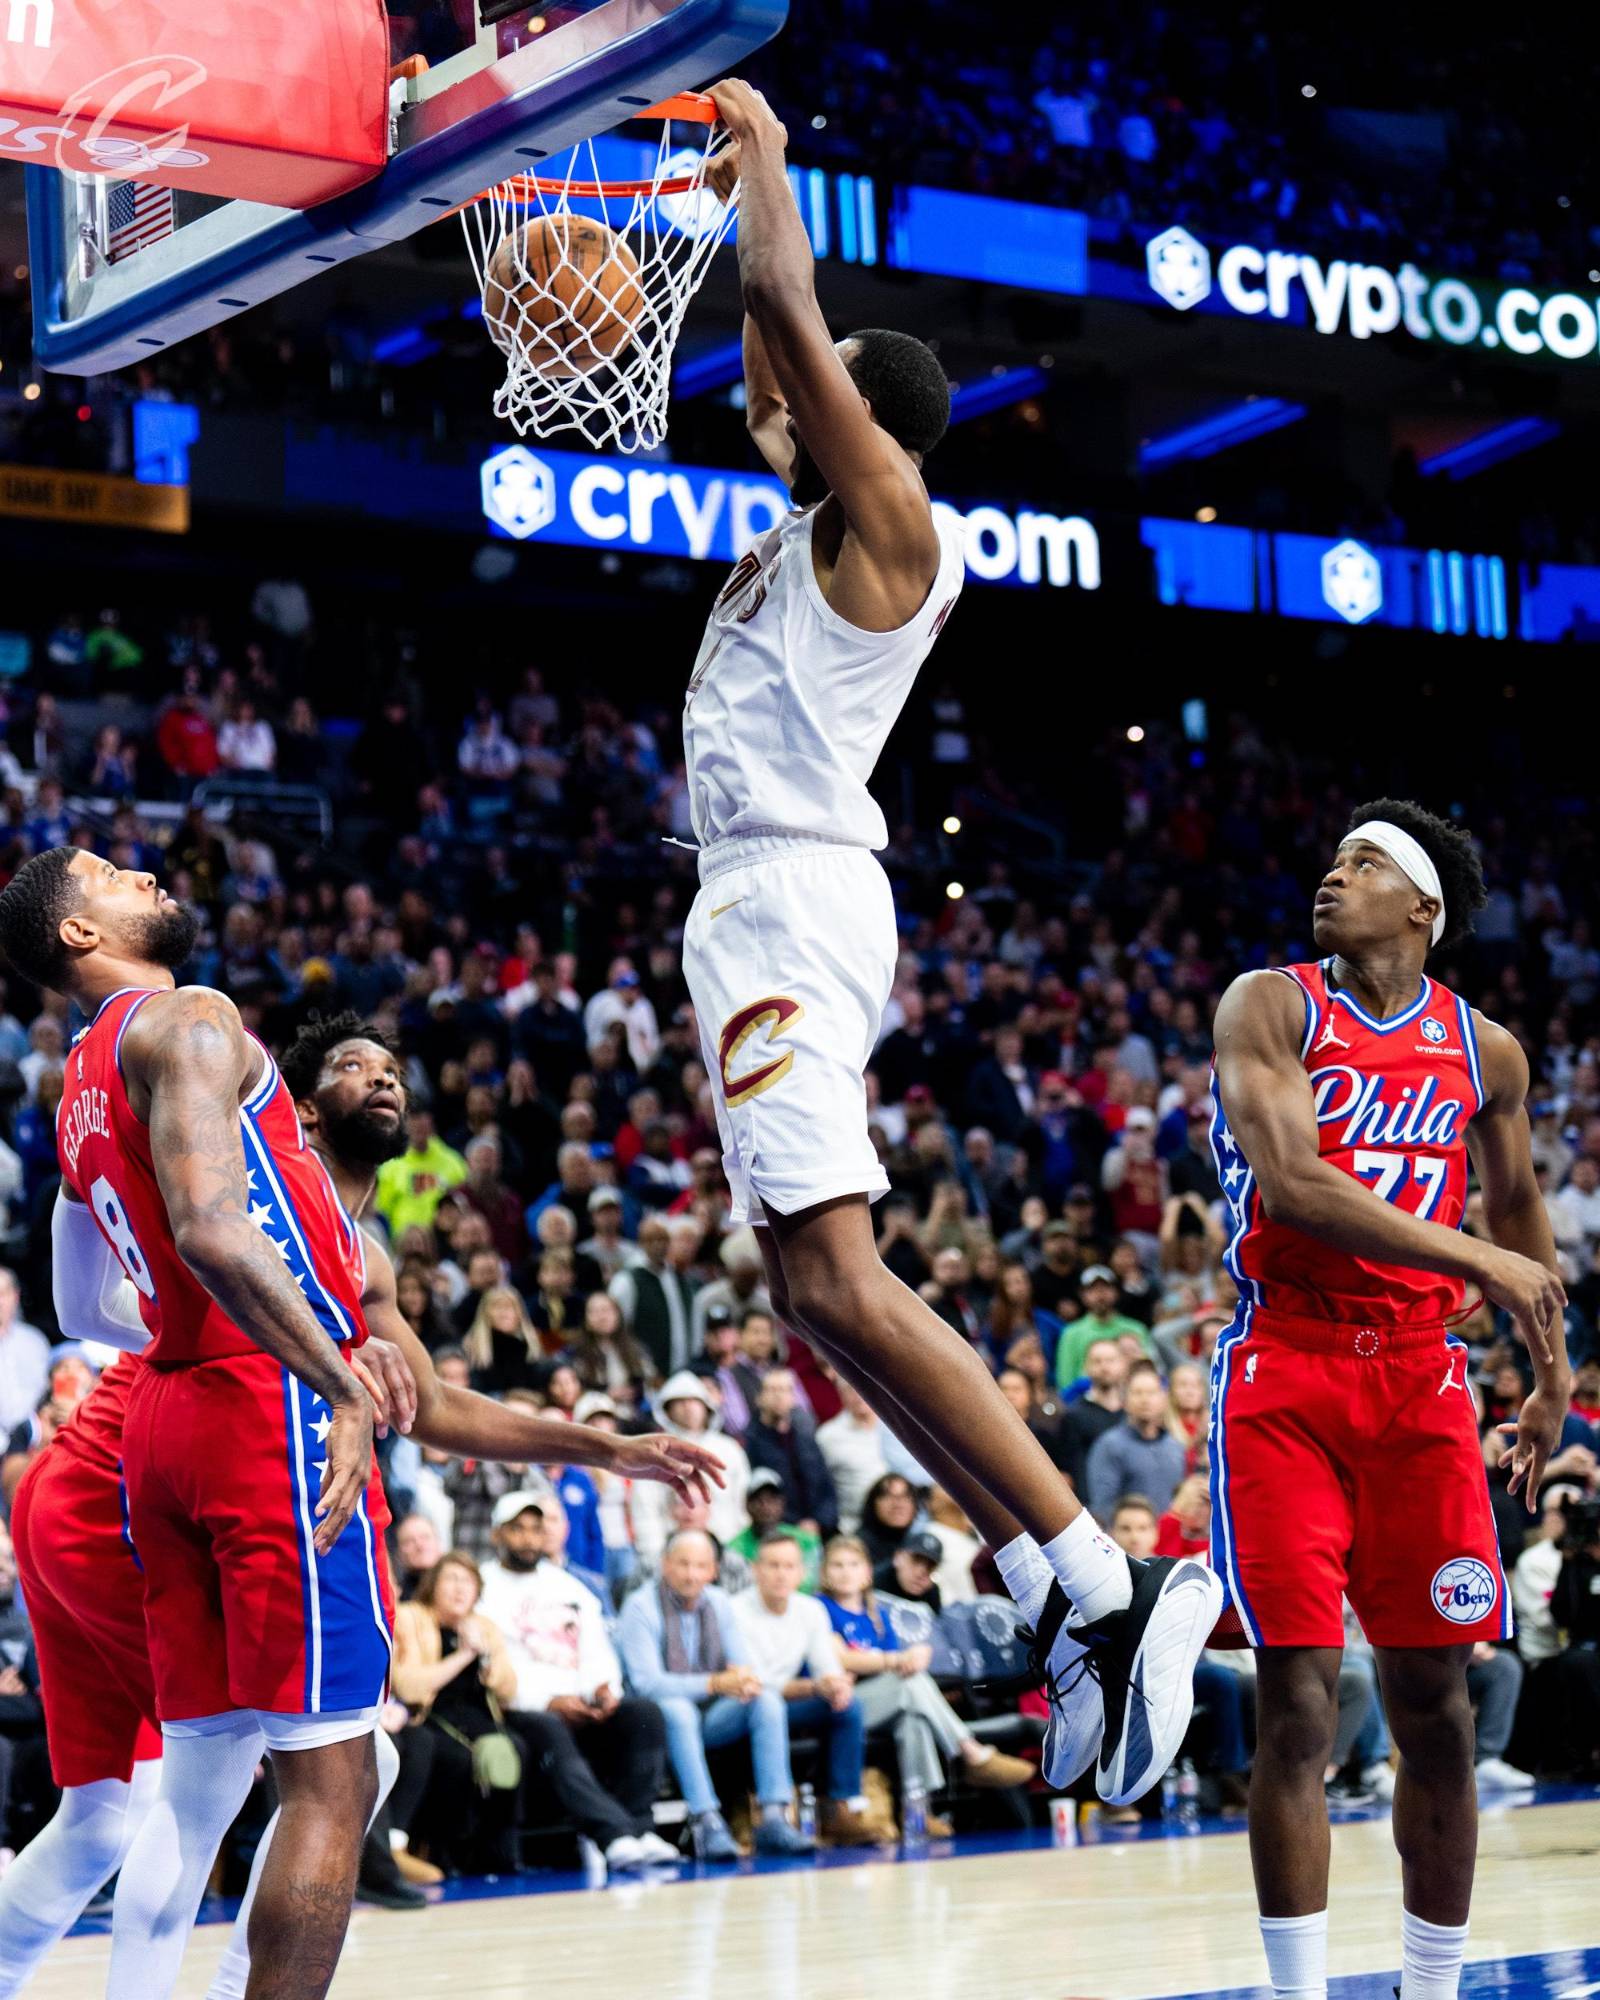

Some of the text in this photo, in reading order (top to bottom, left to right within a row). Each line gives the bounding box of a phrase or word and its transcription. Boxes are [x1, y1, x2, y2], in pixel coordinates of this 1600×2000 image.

[1218, 245, 1600, 359] crypto.co
[719, 995, 805, 1108] C
[1414, 1044, 1463, 1056] crypto.com
[63, 1086, 110, 1173] GEORGE
[1309, 1064, 1464, 1146] Phila
[1353, 1149, 1448, 1219] 77
[90, 1174, 158, 1305] 8
[1439, 1583, 1491, 1607] 76ers
